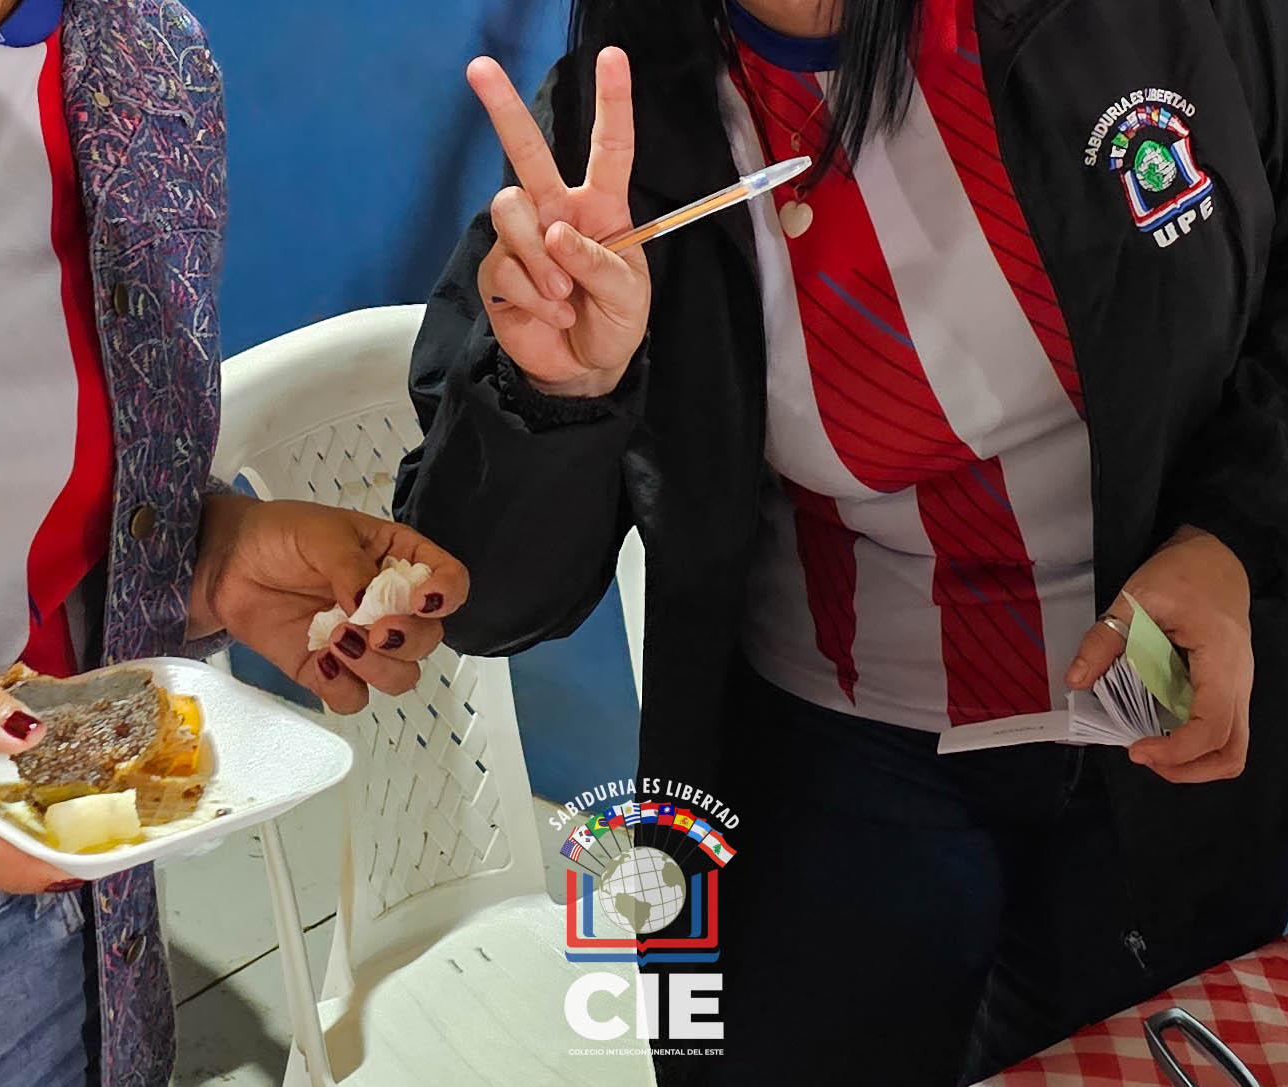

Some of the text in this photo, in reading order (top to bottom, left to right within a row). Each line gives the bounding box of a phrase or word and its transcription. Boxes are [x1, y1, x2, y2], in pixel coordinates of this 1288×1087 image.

[1083, 87, 1196, 167] SABIDURIA ES LIBERTAD
[1152, 196, 1214, 248] UPE
